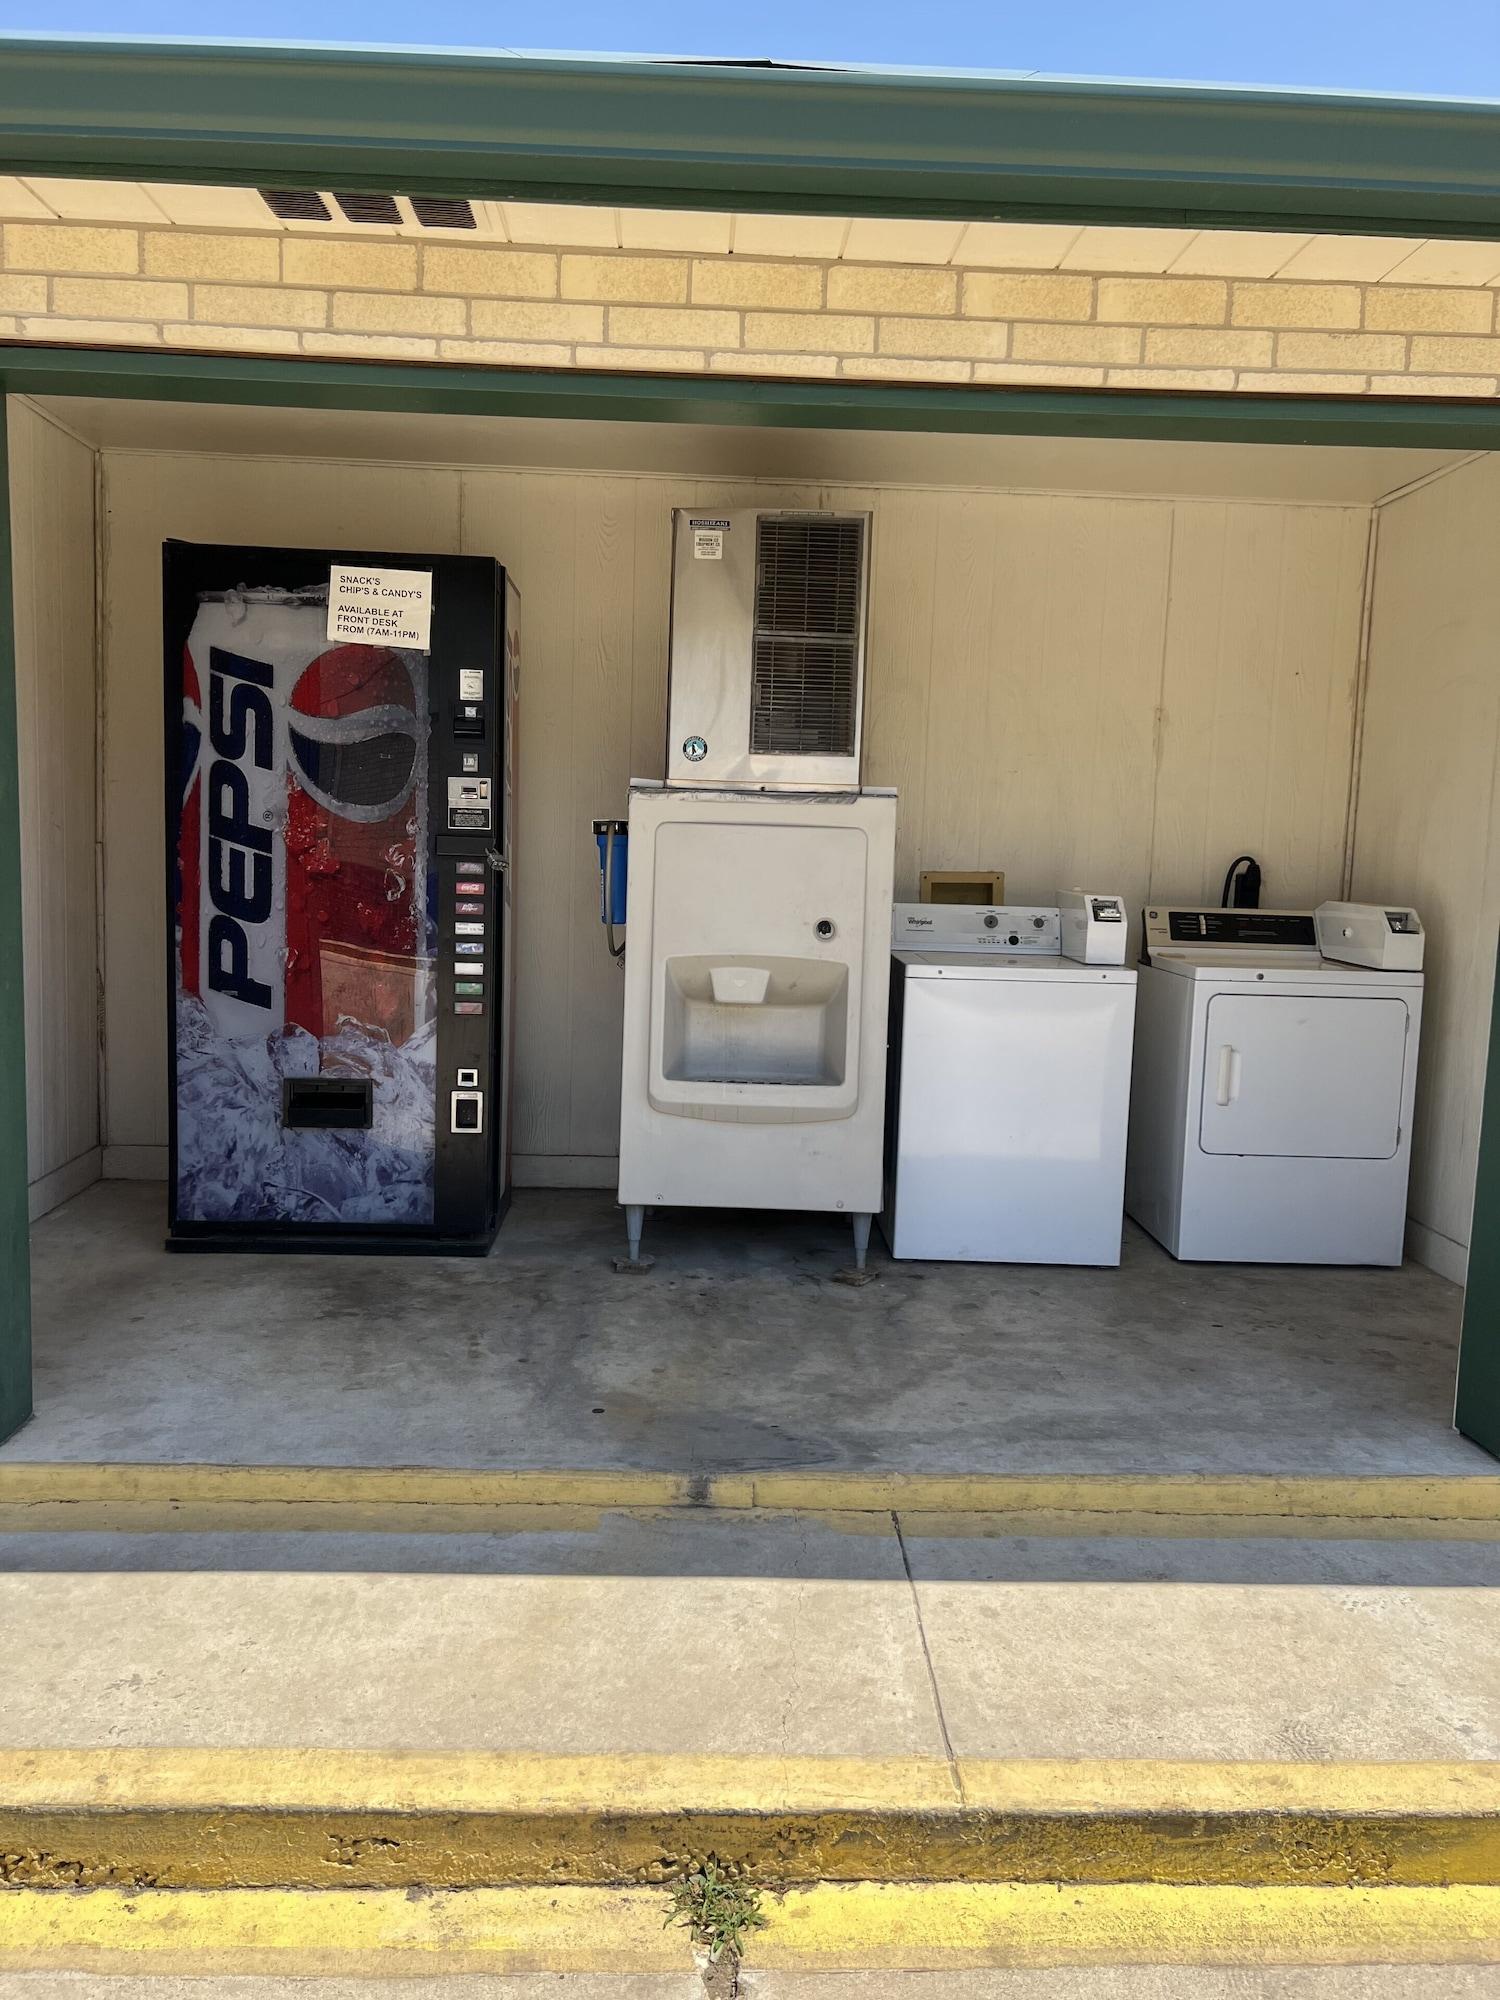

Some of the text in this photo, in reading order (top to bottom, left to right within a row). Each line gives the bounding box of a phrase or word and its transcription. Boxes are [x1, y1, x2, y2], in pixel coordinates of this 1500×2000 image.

[339, 575, 381, 586] SNACK'S
[339, 585, 422, 599] CHIP'S & CANDY'S
[337, 605, 404, 618] AVAILABLE AT
[337, 614, 398, 628] FRONT DESK
[336, 624, 420, 641] FROM (7AM-11PM)
[208, 645, 274, 1010] PEPSI
